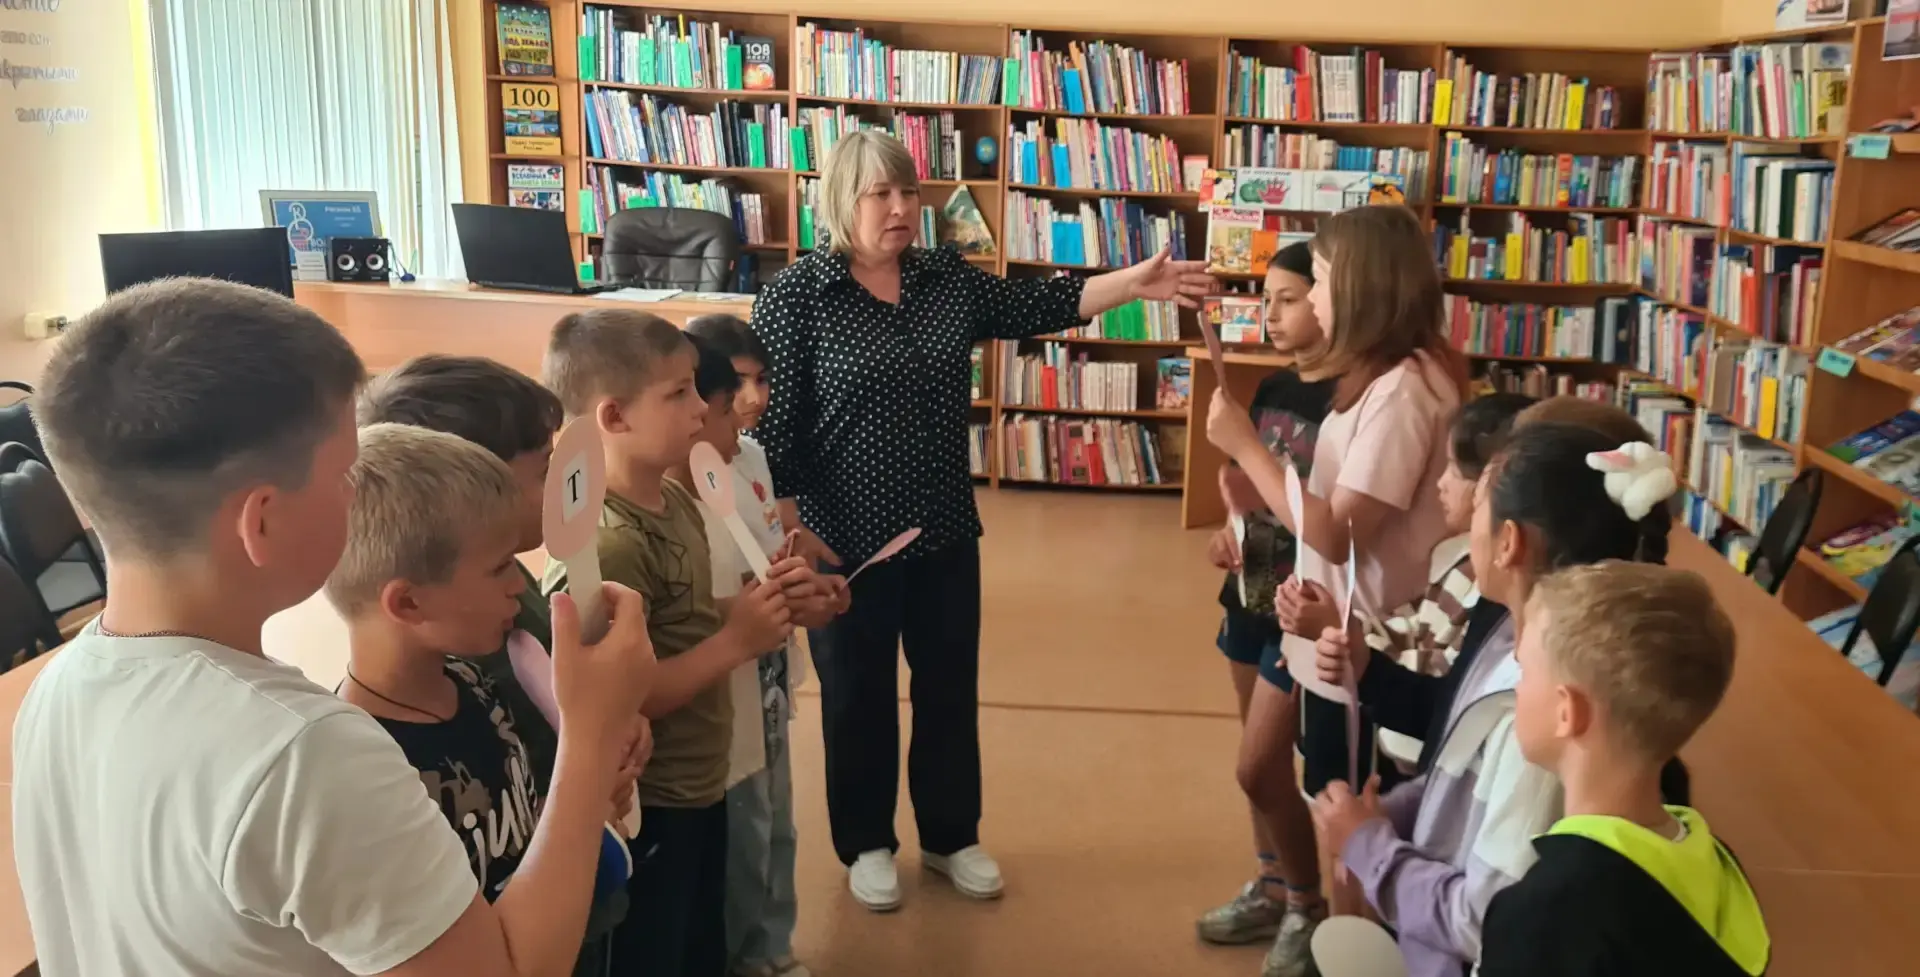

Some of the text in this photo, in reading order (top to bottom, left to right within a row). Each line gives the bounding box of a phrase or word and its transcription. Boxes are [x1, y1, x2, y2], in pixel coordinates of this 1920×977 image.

[745, 43, 770, 56] 108
[509, 88, 551, 108] 100
[567, 469, 582, 504] Т
[706, 471, 716, 489] Р
